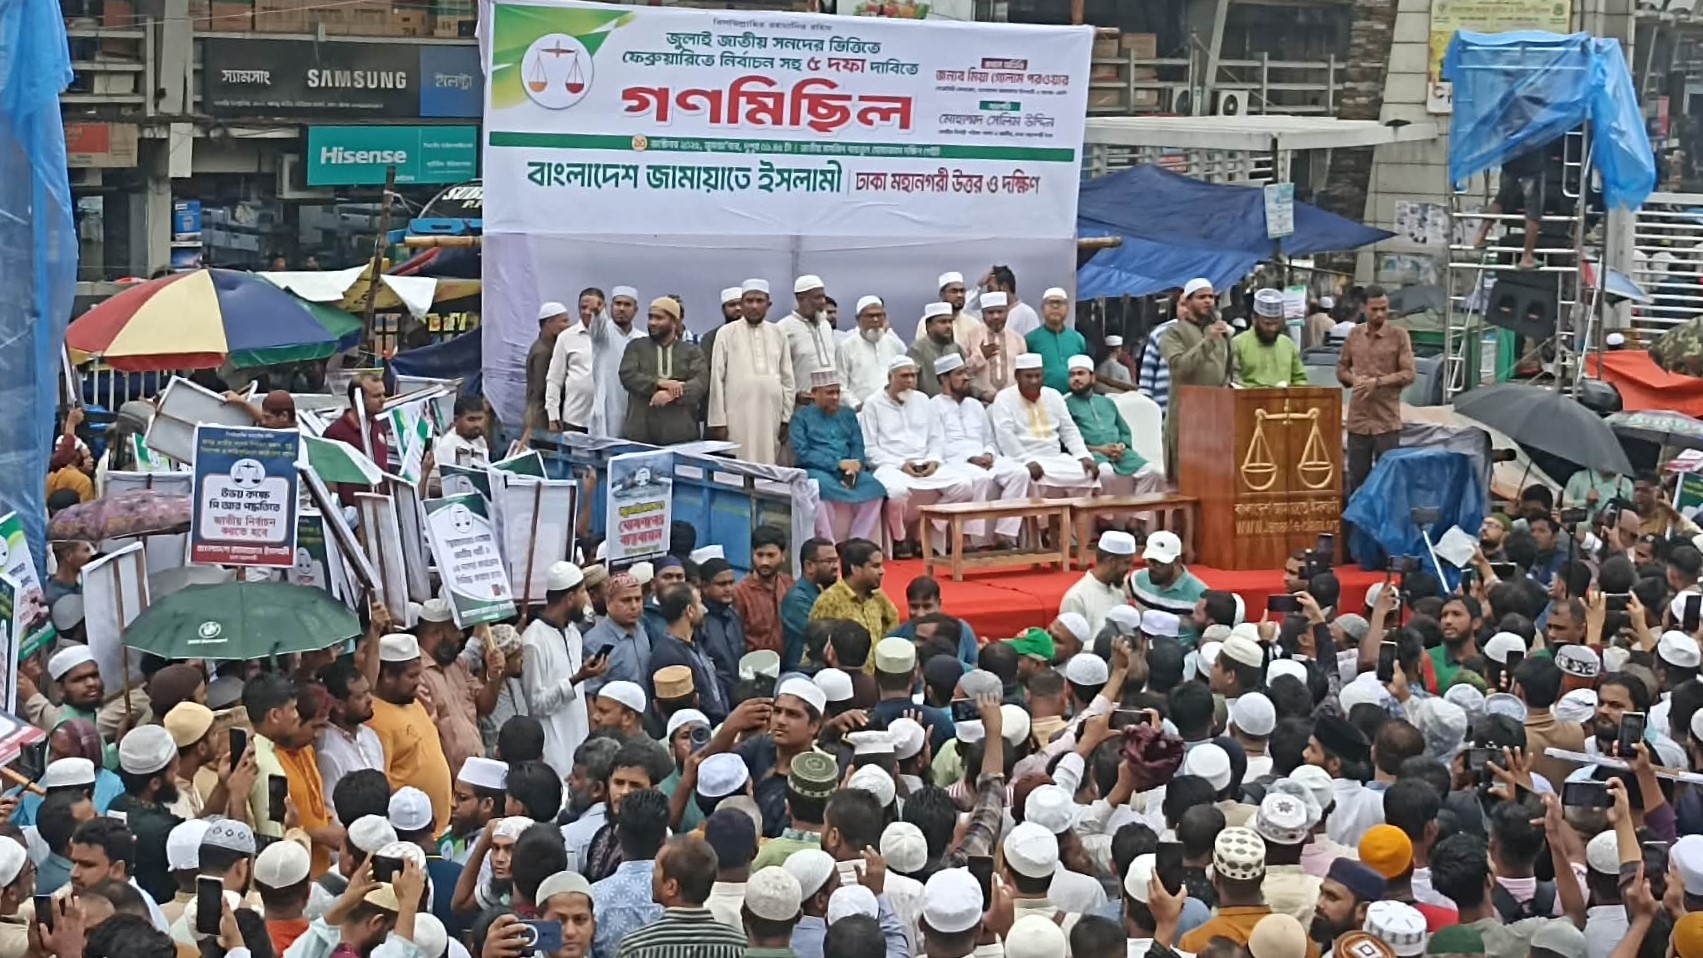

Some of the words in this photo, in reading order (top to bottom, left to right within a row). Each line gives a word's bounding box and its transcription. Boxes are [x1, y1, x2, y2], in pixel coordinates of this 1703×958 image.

[666, 31, 713, 50] জুলাই
[717, 32, 768, 49] জাতীয়
[772, 37, 825, 52] সনদের
[829, 36, 881, 54] ভিত্তিতে
[622, 49, 715, 66] ফেব্রুয়ারিতে
[720, 51, 775, 69] নির্বাচন
[780, 58, 802, 71] সহ
[807, 56, 822, 71] ৫
[827, 57, 867, 73] দফা
[870, 58, 920, 75] দাবিতে
[221, 68, 271, 86] স্যামসাং
[307, 68, 407, 89] SAMSUNG
[936, 69, 965, 82] জনাব
[967, 67, 989, 83] মিয়া
[991, 72, 1024, 84] গোলাম
[1027, 73, 1069, 86] পরওয়ার
[622, 75, 913, 133] গণমিছিল
[987, 112, 1021, 127] সেলিম
[1025, 112, 1055, 128] উদ্দিন
[320, 146, 407, 164] Hisense
[527, 161, 640, 190] বাংলাদেশ
[646, 164, 751, 194] জামায়াতে
[757, 159, 842, 194] ইসলামী
[855, 172, 888, 192] ঢাকা
[890, 166, 949, 193] মহানগরী
[952, 169, 984, 194] উত্তর
[986, 175, 999, 194] ও
[1002, 169, 1041, 195] দক্ষিণ
